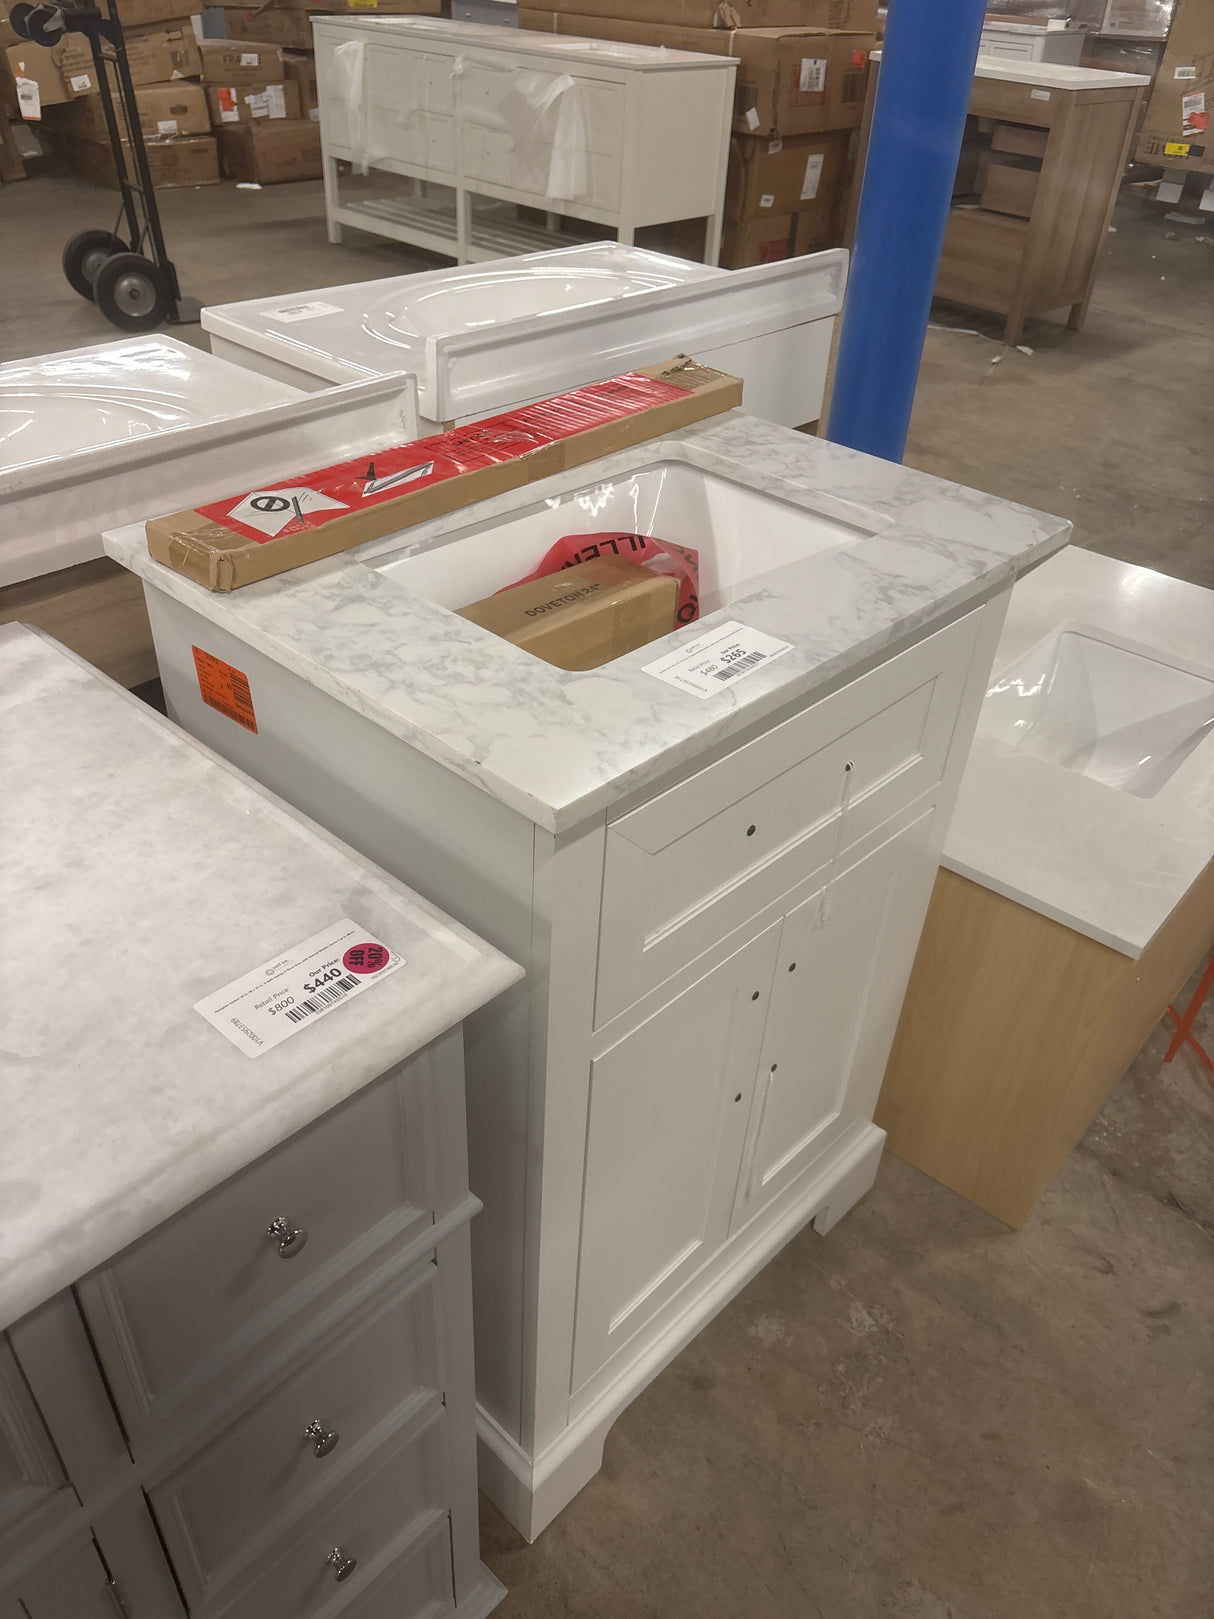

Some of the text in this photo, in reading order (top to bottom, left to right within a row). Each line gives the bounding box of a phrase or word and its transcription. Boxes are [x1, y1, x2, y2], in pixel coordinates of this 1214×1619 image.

[720, 648, 746, 664] $265
[308, 957, 340, 978] Our Price:
[349, 950, 364, 966] OFF
[367, 946, 384, 969] 20%
[303, 968, 342, 993] $440
[254, 997, 274, 1010] Retail
[268, 996, 295, 1016] $800
